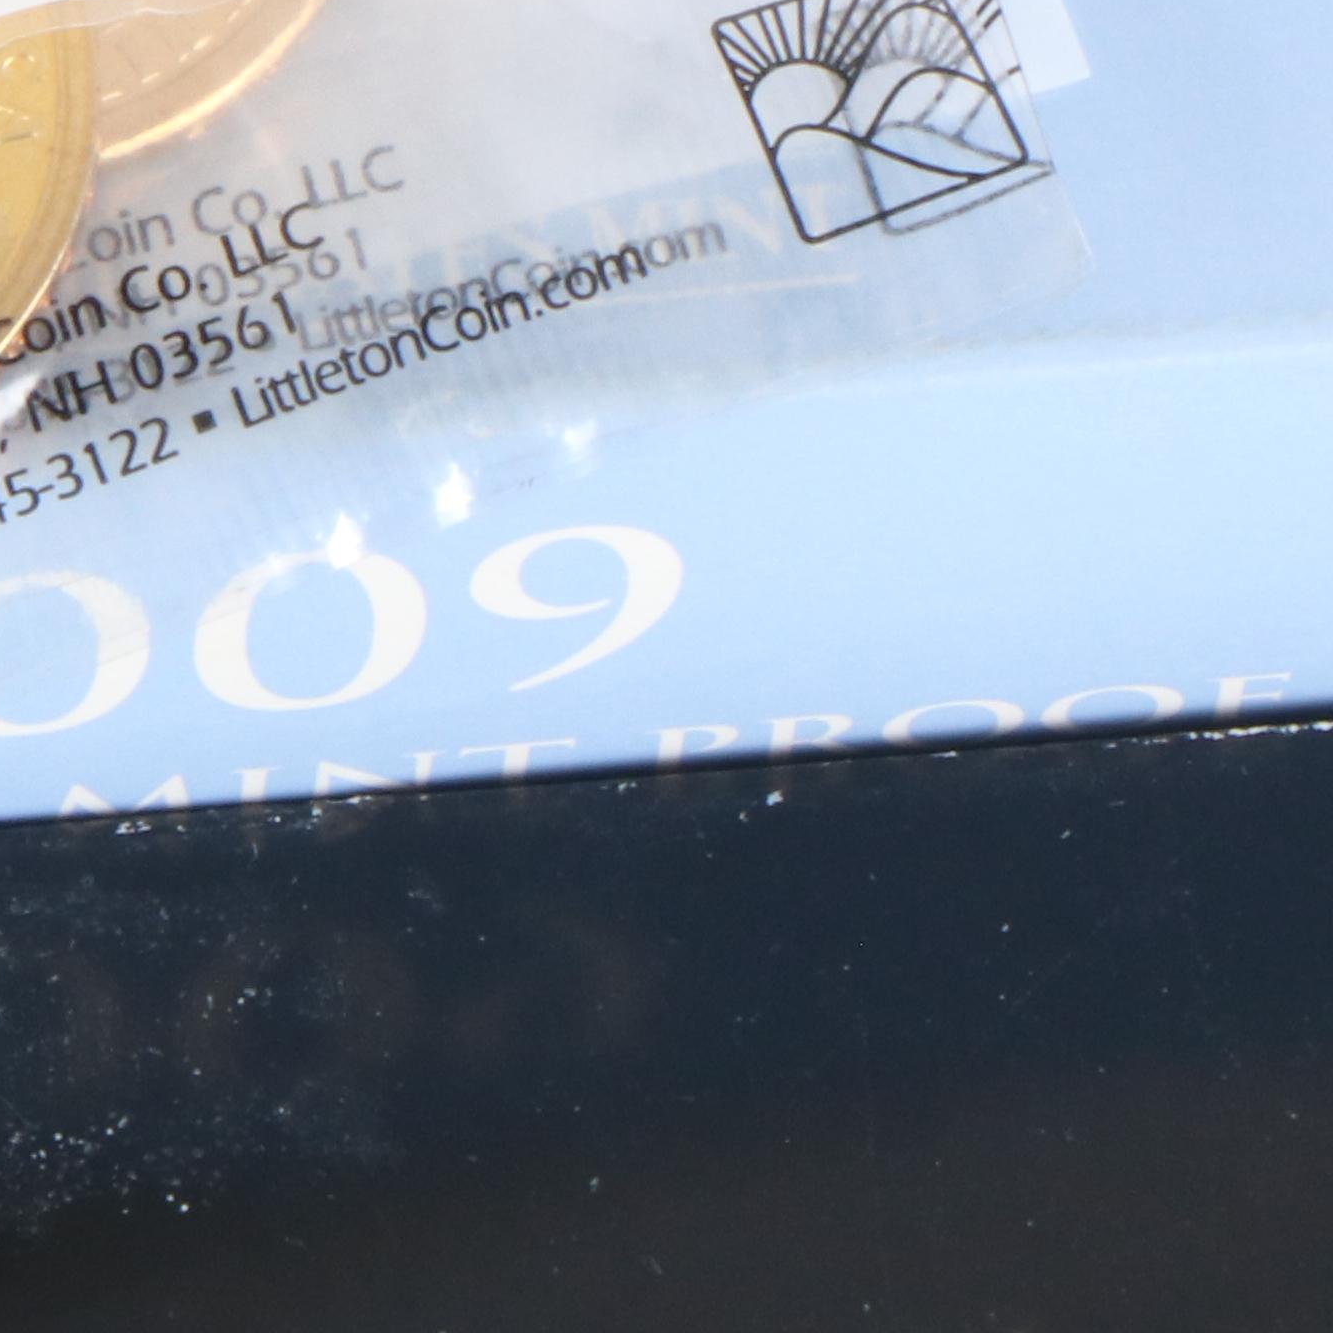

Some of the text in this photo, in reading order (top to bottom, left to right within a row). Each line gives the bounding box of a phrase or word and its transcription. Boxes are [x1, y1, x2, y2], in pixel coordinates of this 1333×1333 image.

[71, 209, 175, 269] oin
[301, 145, 404, 208] LLC
[120, 263, 207, 313] Co.
[220, 201, 324, 279] LLC
[25, 359, 116, 435] NH
[129, 291, 299, 391] 03561
[232, 243, 647, 428] LittletonCoin.com
